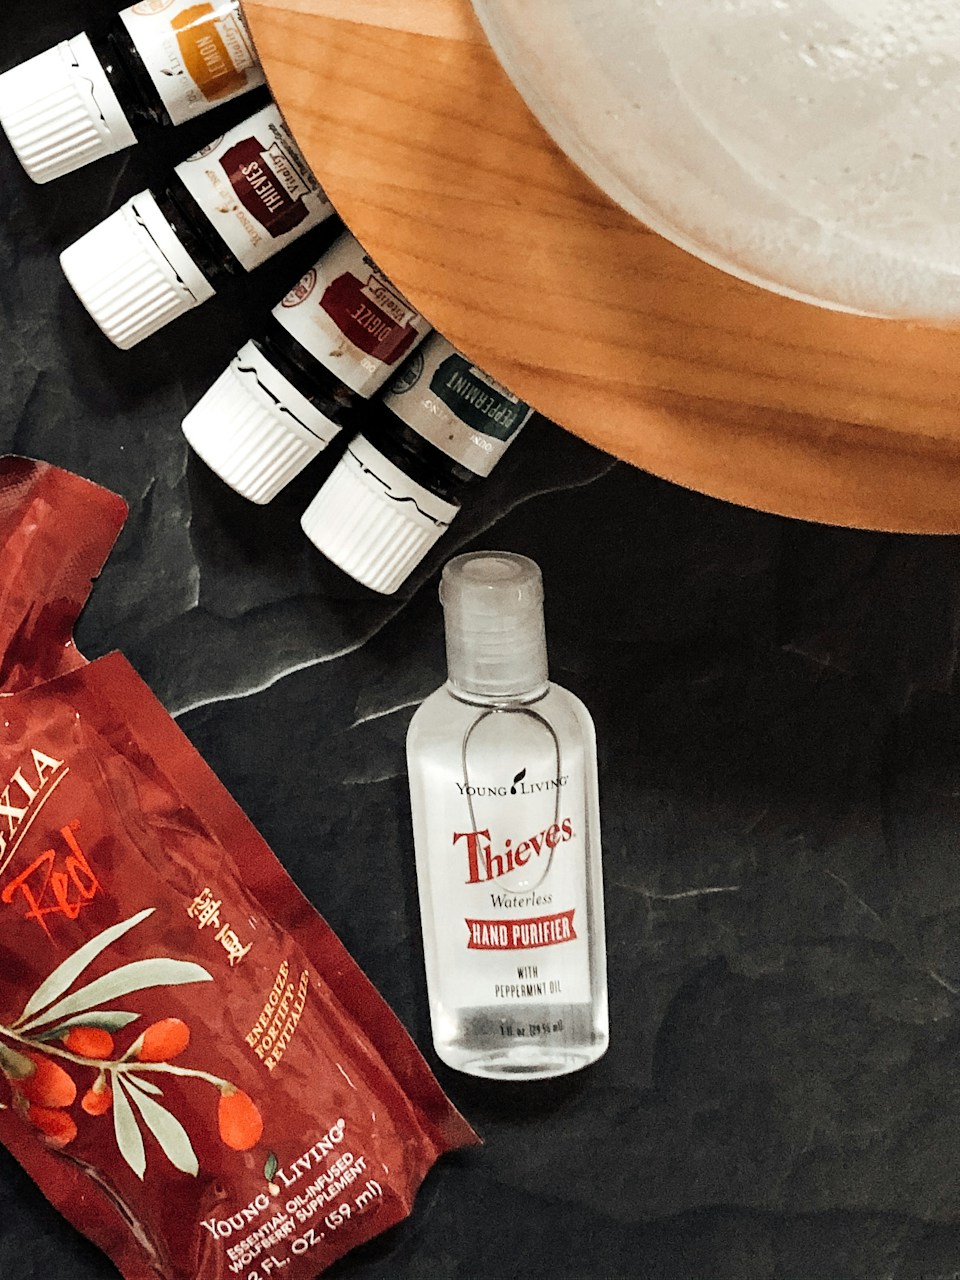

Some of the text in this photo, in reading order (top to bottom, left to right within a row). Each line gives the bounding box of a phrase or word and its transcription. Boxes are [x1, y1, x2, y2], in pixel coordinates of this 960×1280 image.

[195, 34, 228, 78] LEMON
[239, 158, 285, 212] THIEVES
[235, 210, 263, 247] YOUNG
[444, 370, 517, 429] PEPPERMINT
[455, 781, 507, 797] YOUNG
[452, 817, 574, 885] Thieves
[490, 892, 553, 909] Waterless
[472, 917, 571, 947] HAND PURIFIER
[495, 980, 562, 998] PEPPERMINT OIL
[517, 966, 539, 979] WITH
[200, 1193, 270, 1239] YOUNG
[226, 1152, 354, 1261] ESSENTIAL OIL-INFUSED
[228, 1157, 368, 1274] WOLFBERRY SUPPLEMENT
[261, 1255, 290, 1275] FL.
[291, 1228, 325, 1256] OZ.
[324, 1203, 353, 1231] (59
[355, 1179, 382, 1208] ml)
